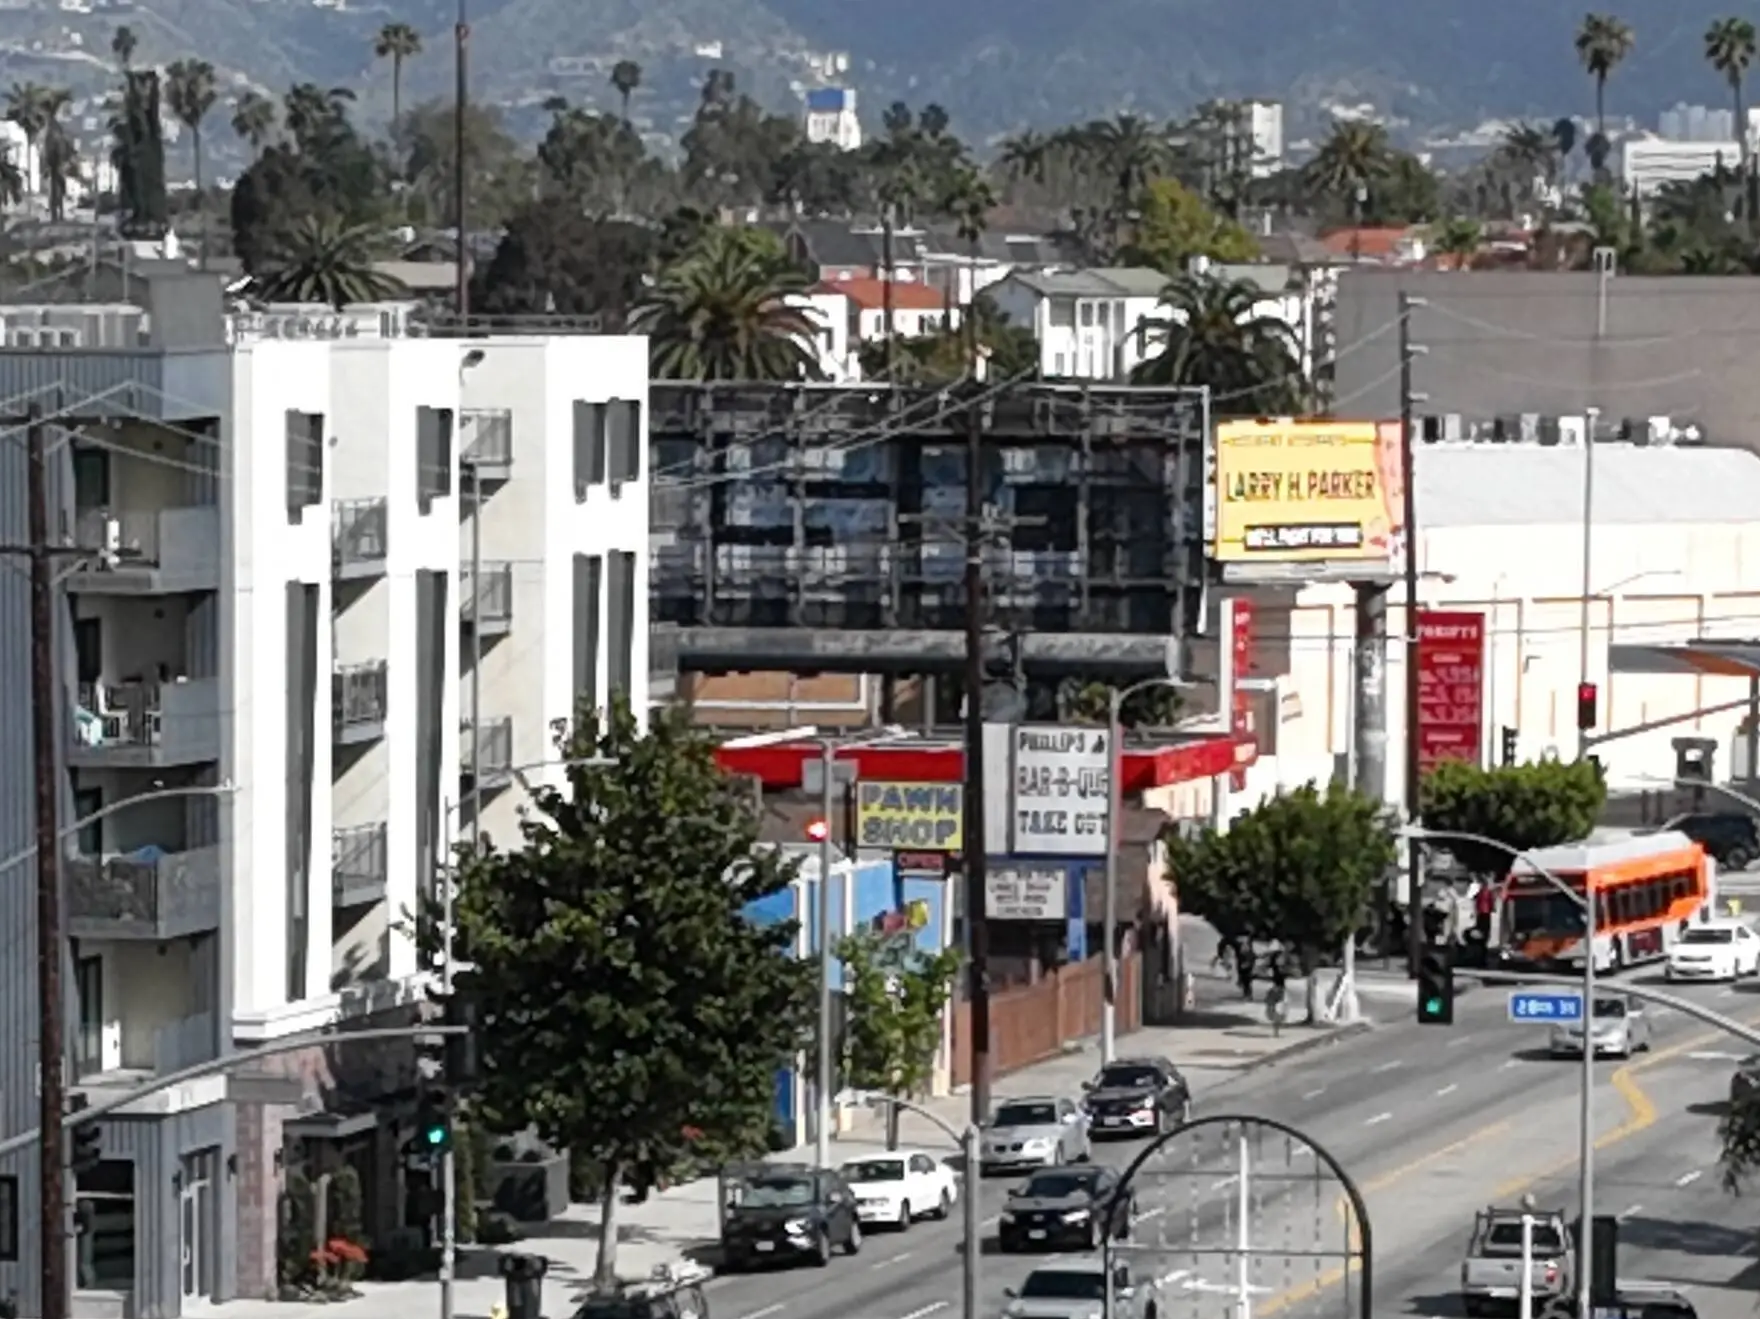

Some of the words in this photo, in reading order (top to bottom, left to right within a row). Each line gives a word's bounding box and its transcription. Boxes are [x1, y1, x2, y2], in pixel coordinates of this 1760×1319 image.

[1226, 471, 1283, 502] LARRY
[1308, 469, 1375, 500] PARKER
[1019, 732, 1085, 752] PHILLIPS
[862, 784, 958, 814] PAWN
[862, 816, 957, 844] SHOP
[1018, 810, 1067, 834] TAKE
[1075, 811, 1108, 835] OUT
